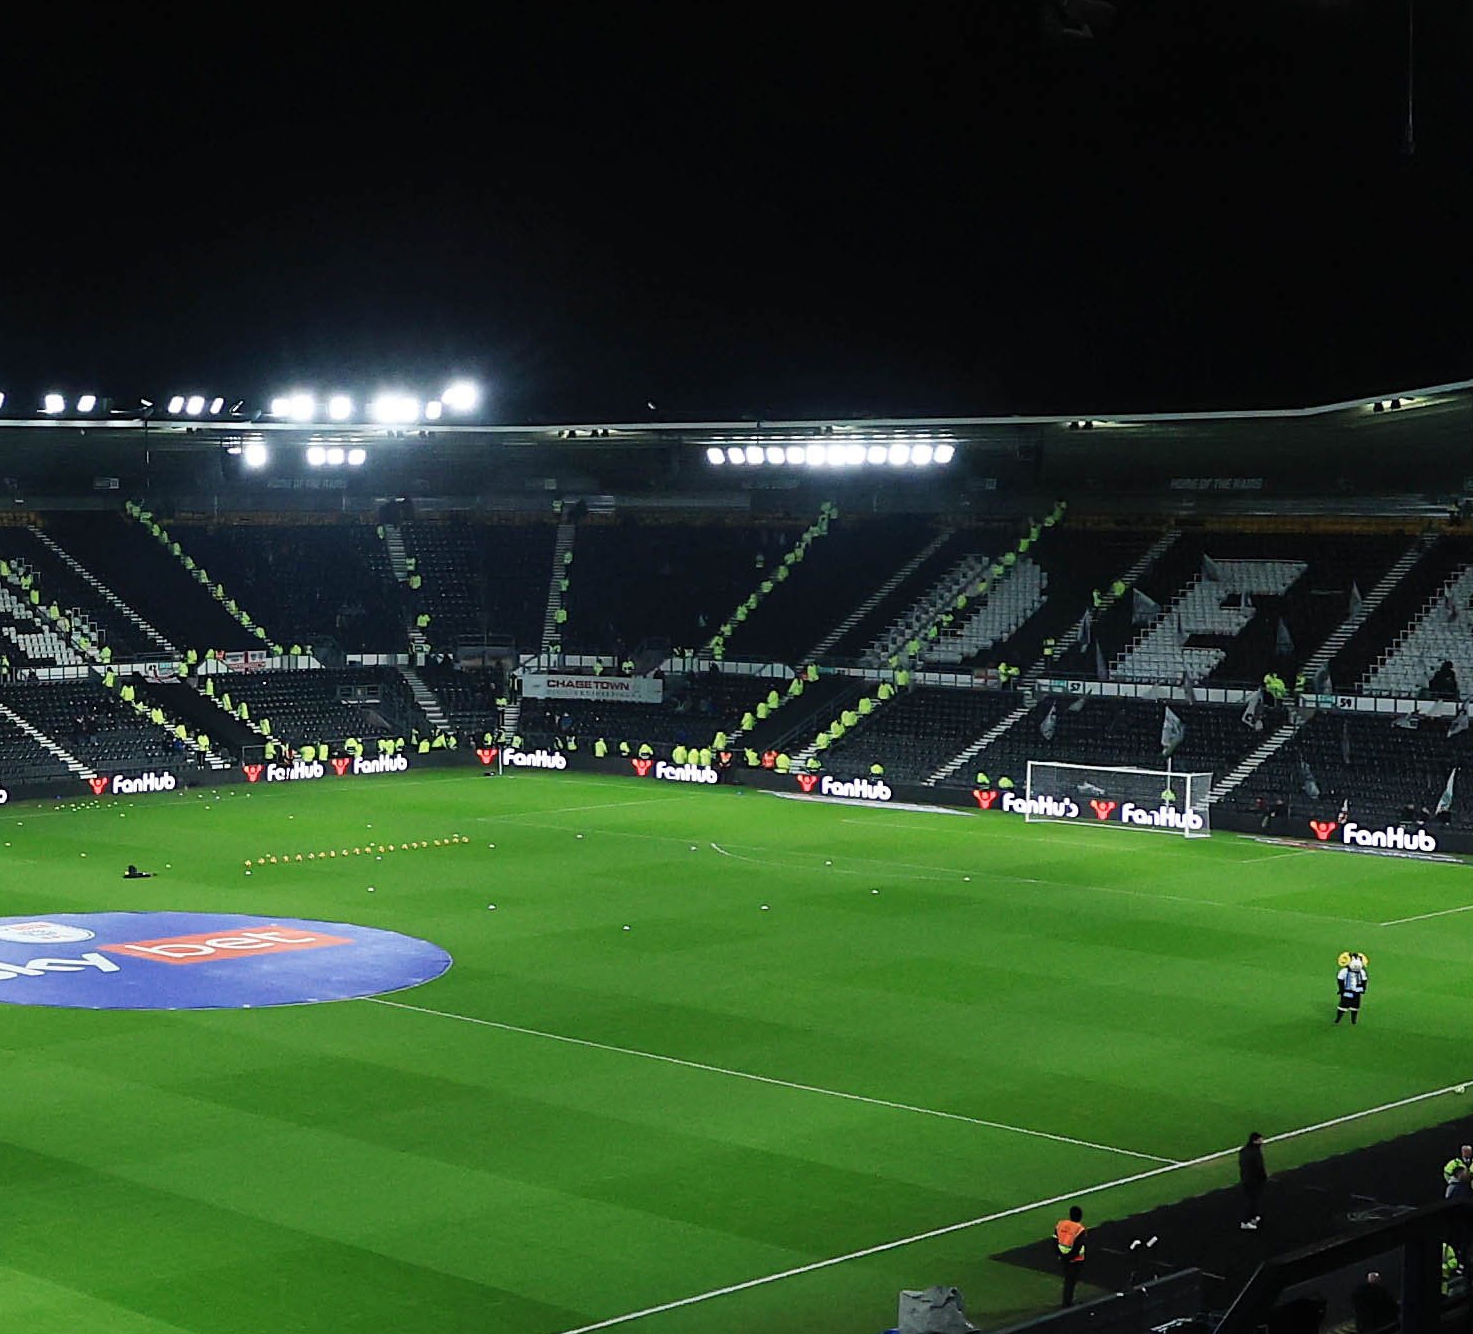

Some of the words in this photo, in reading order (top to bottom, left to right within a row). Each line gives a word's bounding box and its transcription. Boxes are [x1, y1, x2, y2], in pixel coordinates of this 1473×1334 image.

[353, 753, 408, 775] FanHub
[501, 749, 567, 772] FanHub
[112, 771, 176, 794] FanHub
[821, 777, 892, 801] FanHub
[1120, 802, 1204, 830] FanHub
[1343, 822, 1436, 853] FanHub
[124, 929, 317, 958] bet
